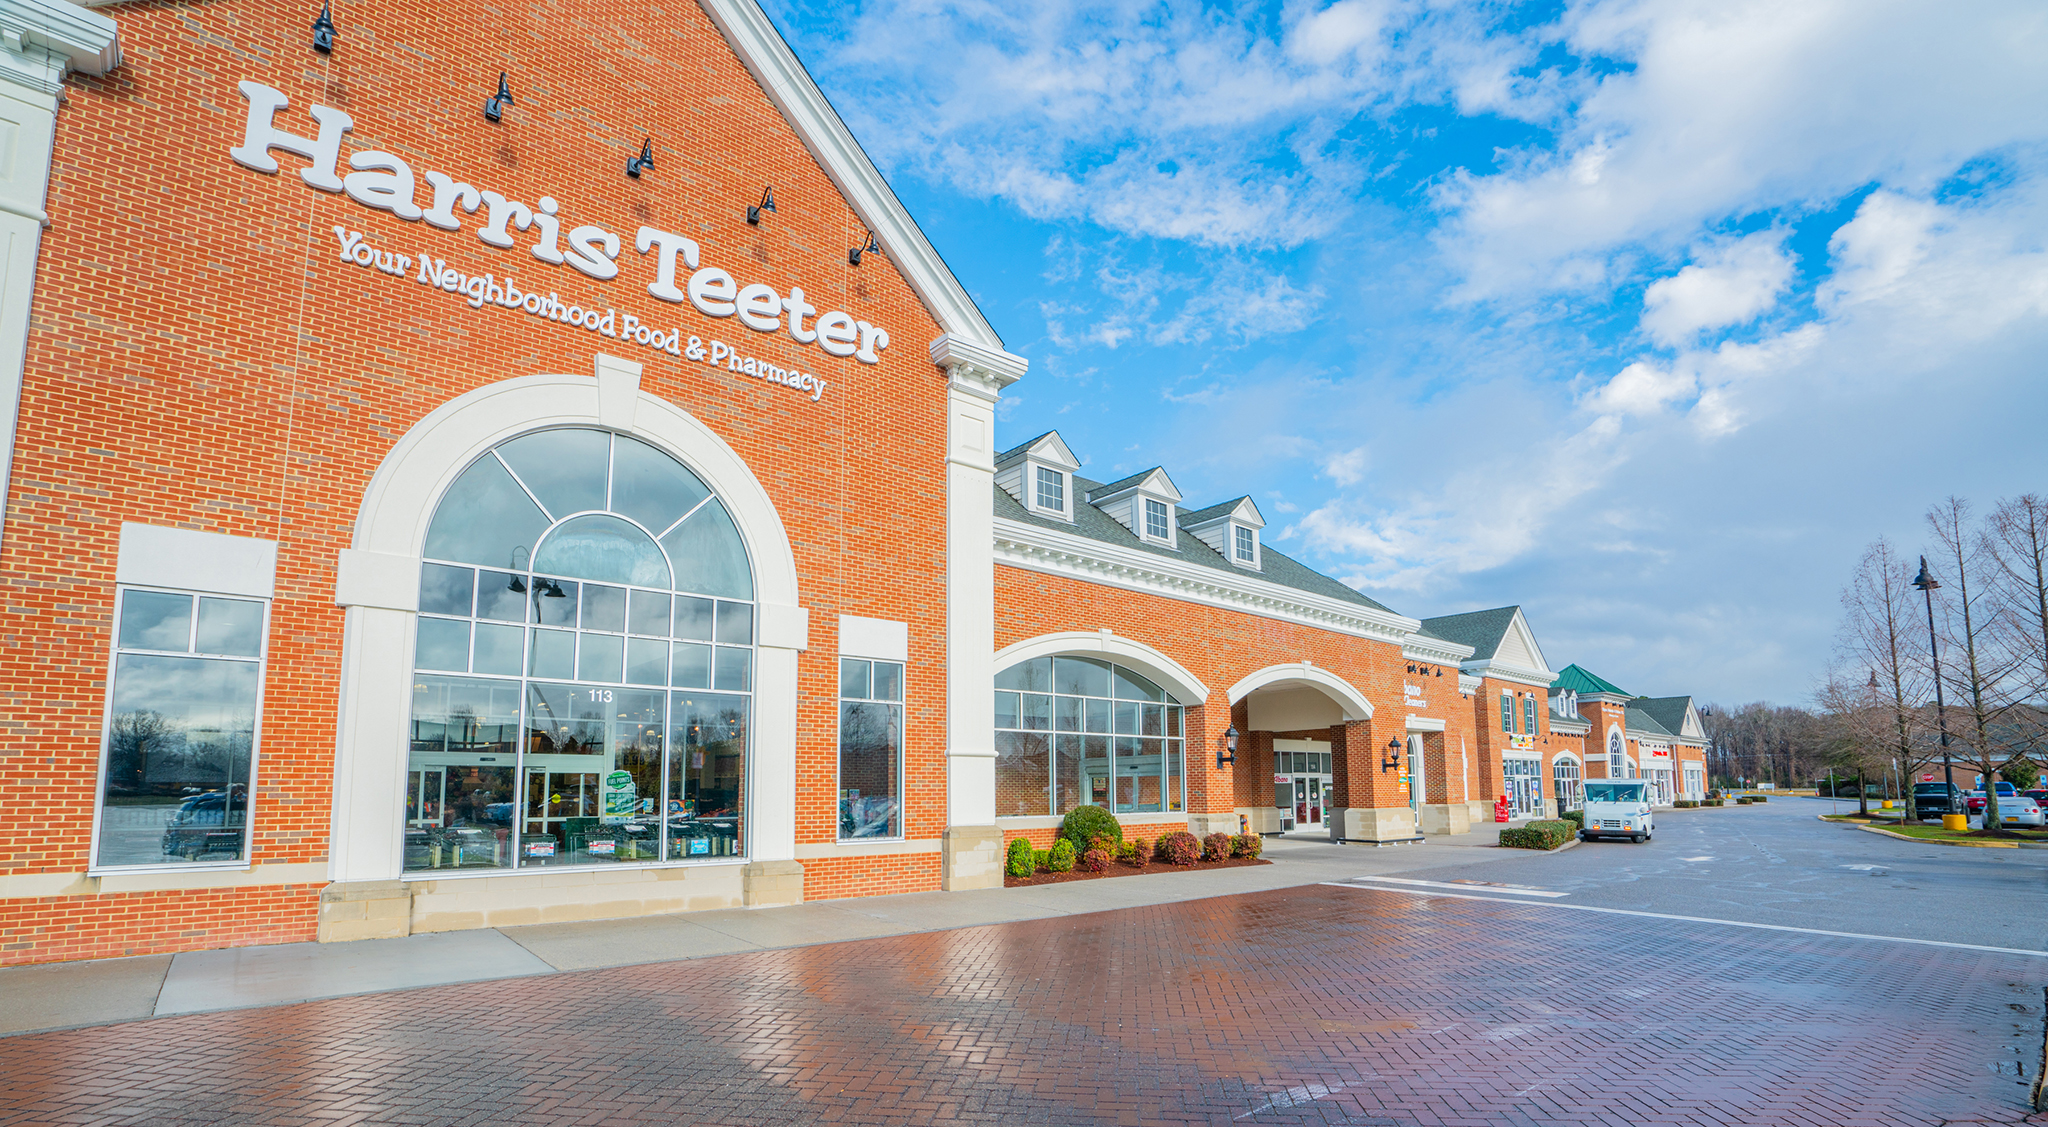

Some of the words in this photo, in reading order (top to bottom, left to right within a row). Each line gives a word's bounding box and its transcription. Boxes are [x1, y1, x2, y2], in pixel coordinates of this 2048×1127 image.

[230, 79, 620, 280] Harris
[635, 225, 890, 365] Teeter
[333, 225, 412, 277] Your
[416, 253, 617, 338] Neighborhood
[620, 314, 681, 356] Food
[685, 335, 707, 362] &
[709, 340, 827, 403] Pharmacy
[588, 688, 613, 703] 113
